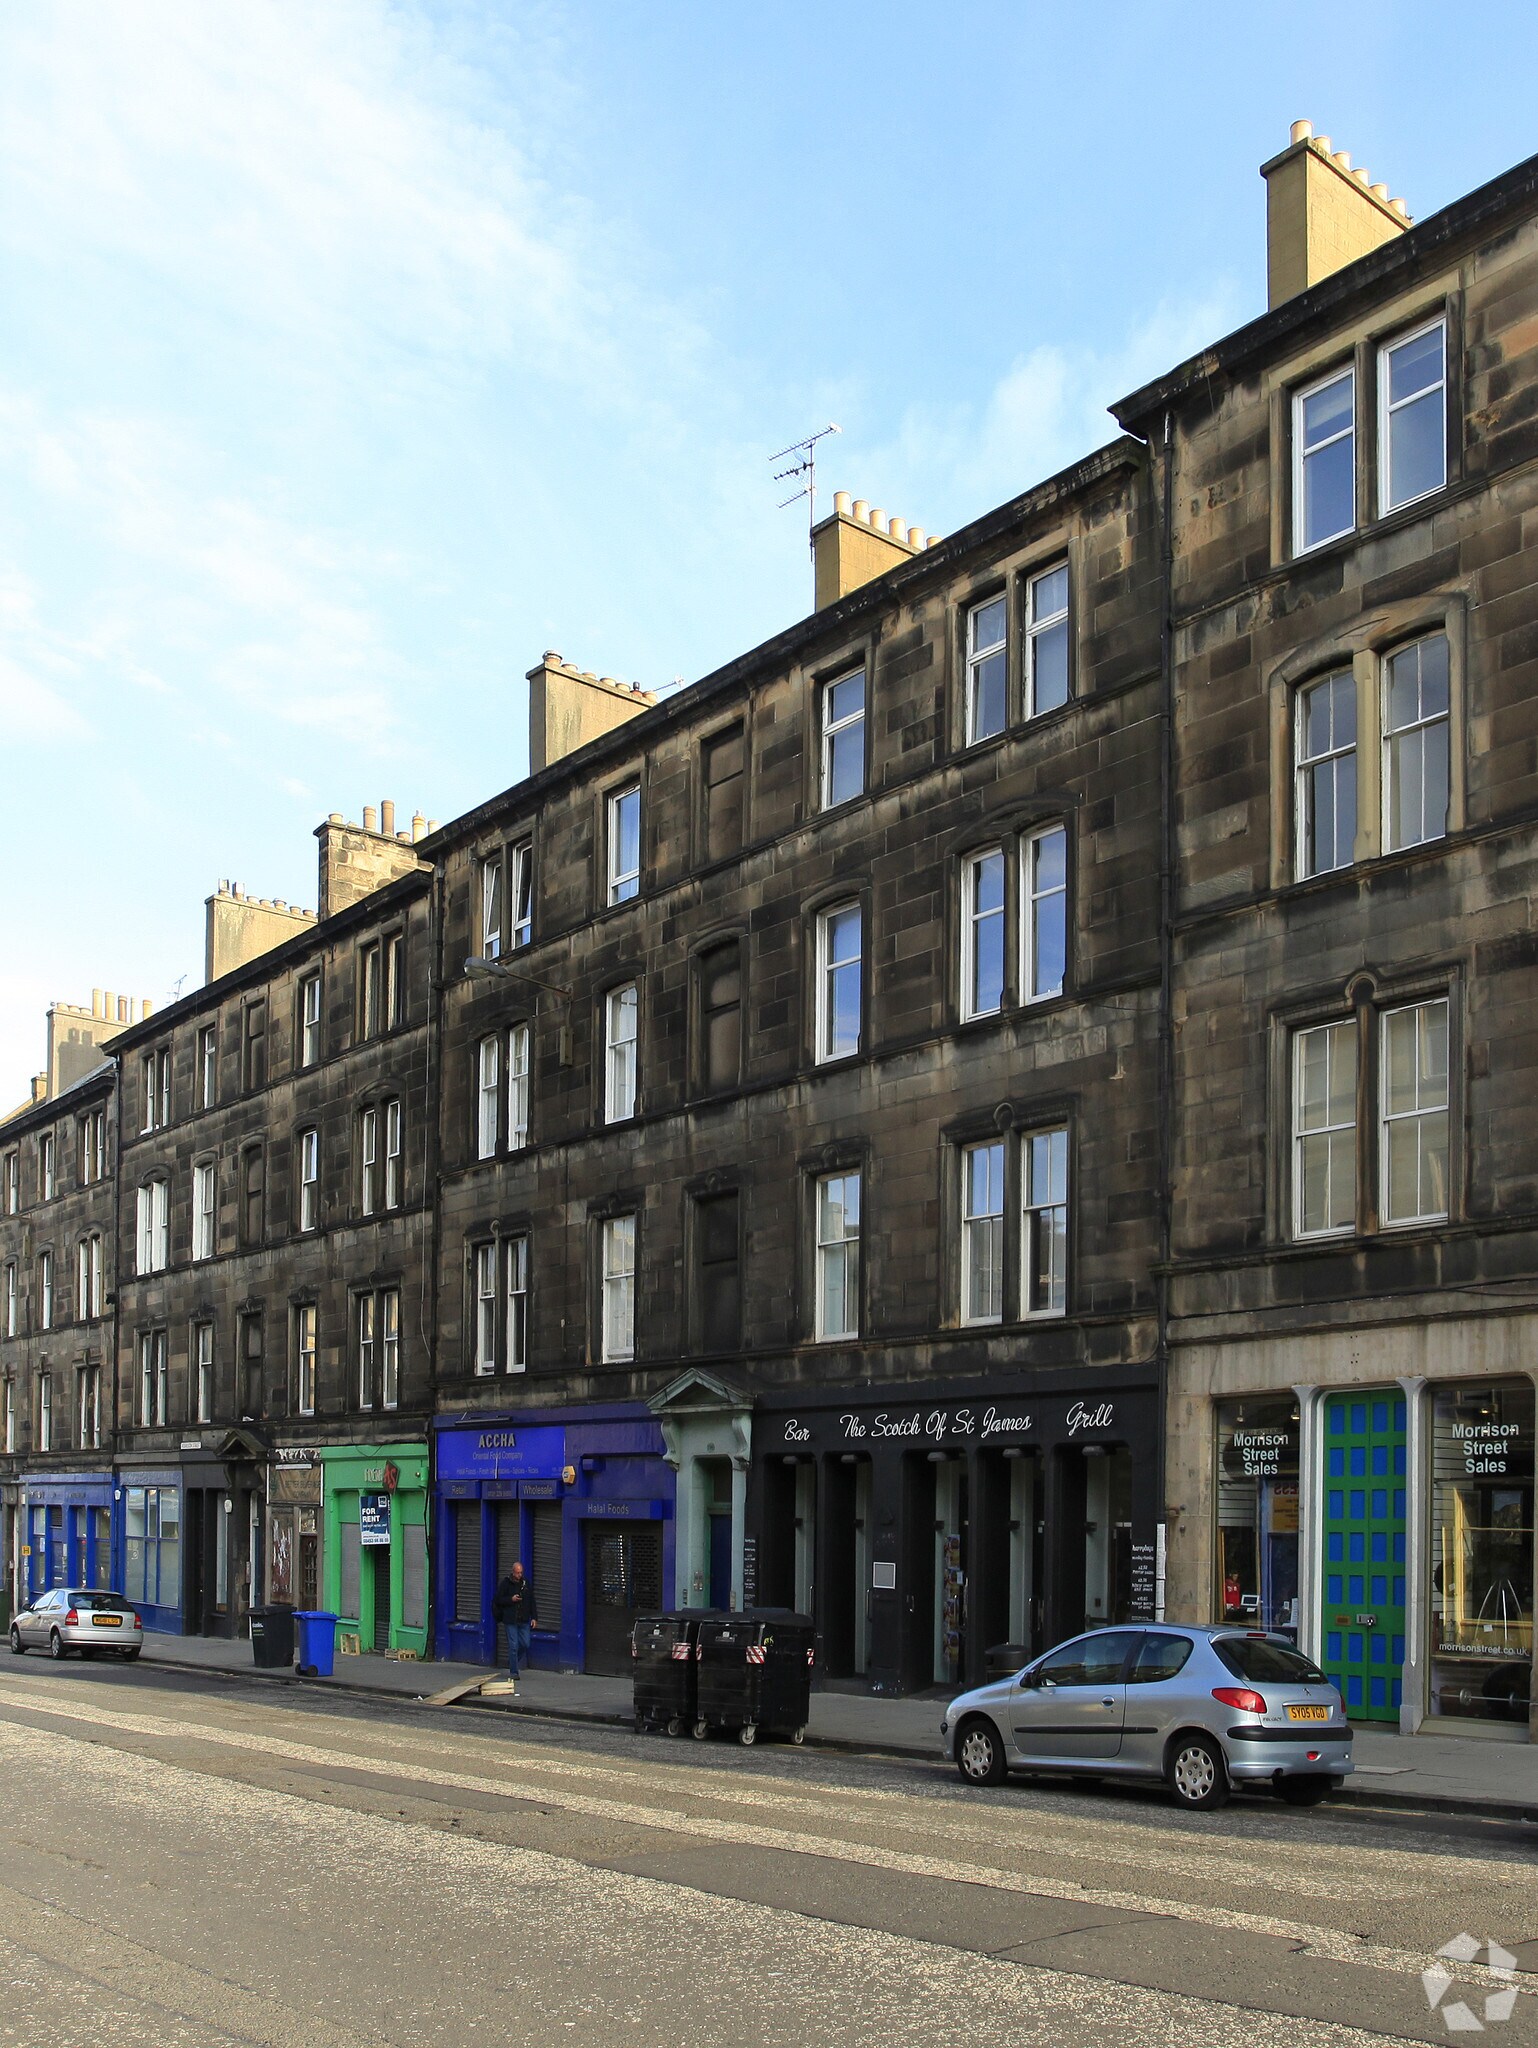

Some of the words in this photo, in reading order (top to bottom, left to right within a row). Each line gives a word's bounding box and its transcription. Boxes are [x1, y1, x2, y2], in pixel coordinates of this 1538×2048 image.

[839, 1414, 866, 1437] The
[870, 1413, 921, 1437] Scotch
[925, 1410, 947, 1441] Of
[951, 1409, 975, 1434] St
[980, 1406, 1032, 1438] James
[1066, 1401, 1113, 1436] Grill
[784, 1419, 810, 1441] Bar
[1451, 1421, 1519, 1438] Morrison
[478, 1433, 515, 1448] ACCHA
[1233, 1432, 1288, 1447] Morrison
[1242, 1447, 1279, 1461] Street
[1463, 1440, 1508, 1455] Street
[1244, 1462, 1278, 1475] Sales
[1465, 1458, 1506, 1474] Sales
[451, 1485, 466, 1495] Retail
[522, 1485, 553, 1495] Wholesale
[362, 1507, 376, 1515] FOR
[587, 1503, 606, 1514] Halal
[607, 1503, 629, 1515] Foods
[362, 1515, 380, 1523] RENT
[1439, 1643, 1529, 1656] morrisonstreet.co.uk
[1291, 1706, 1311, 1719] SY05
